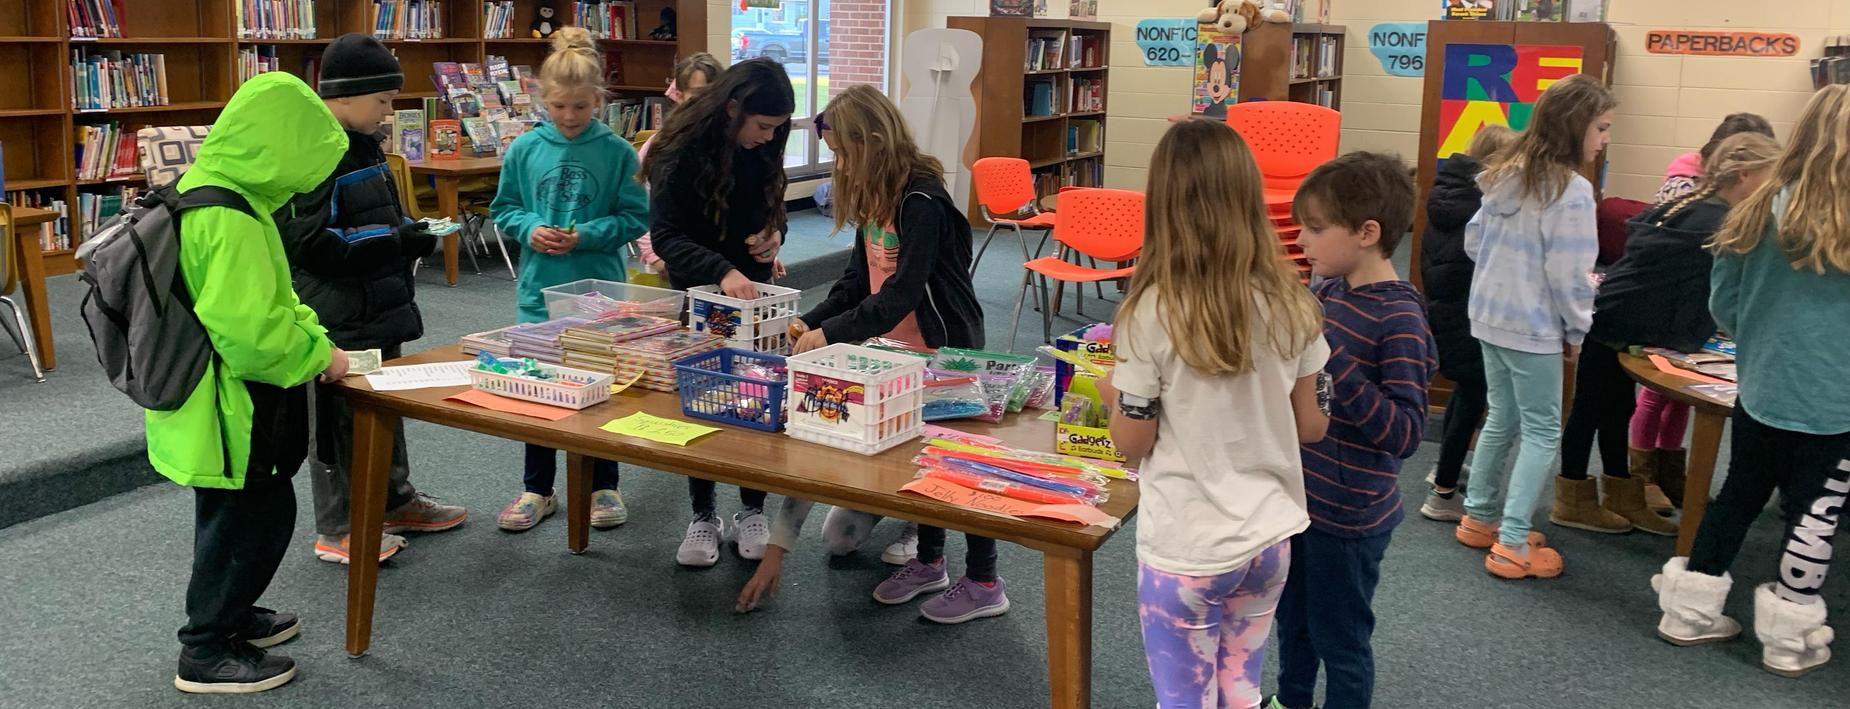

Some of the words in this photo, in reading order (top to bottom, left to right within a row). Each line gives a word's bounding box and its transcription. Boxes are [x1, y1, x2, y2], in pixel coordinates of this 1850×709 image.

[1373, 31, 1425, 47] NONF
[1647, 33, 1797, 54] PAPERBACKS
[1069, 433, 1111, 449] Gadgetz
[924, 484, 959, 504] Jelly
